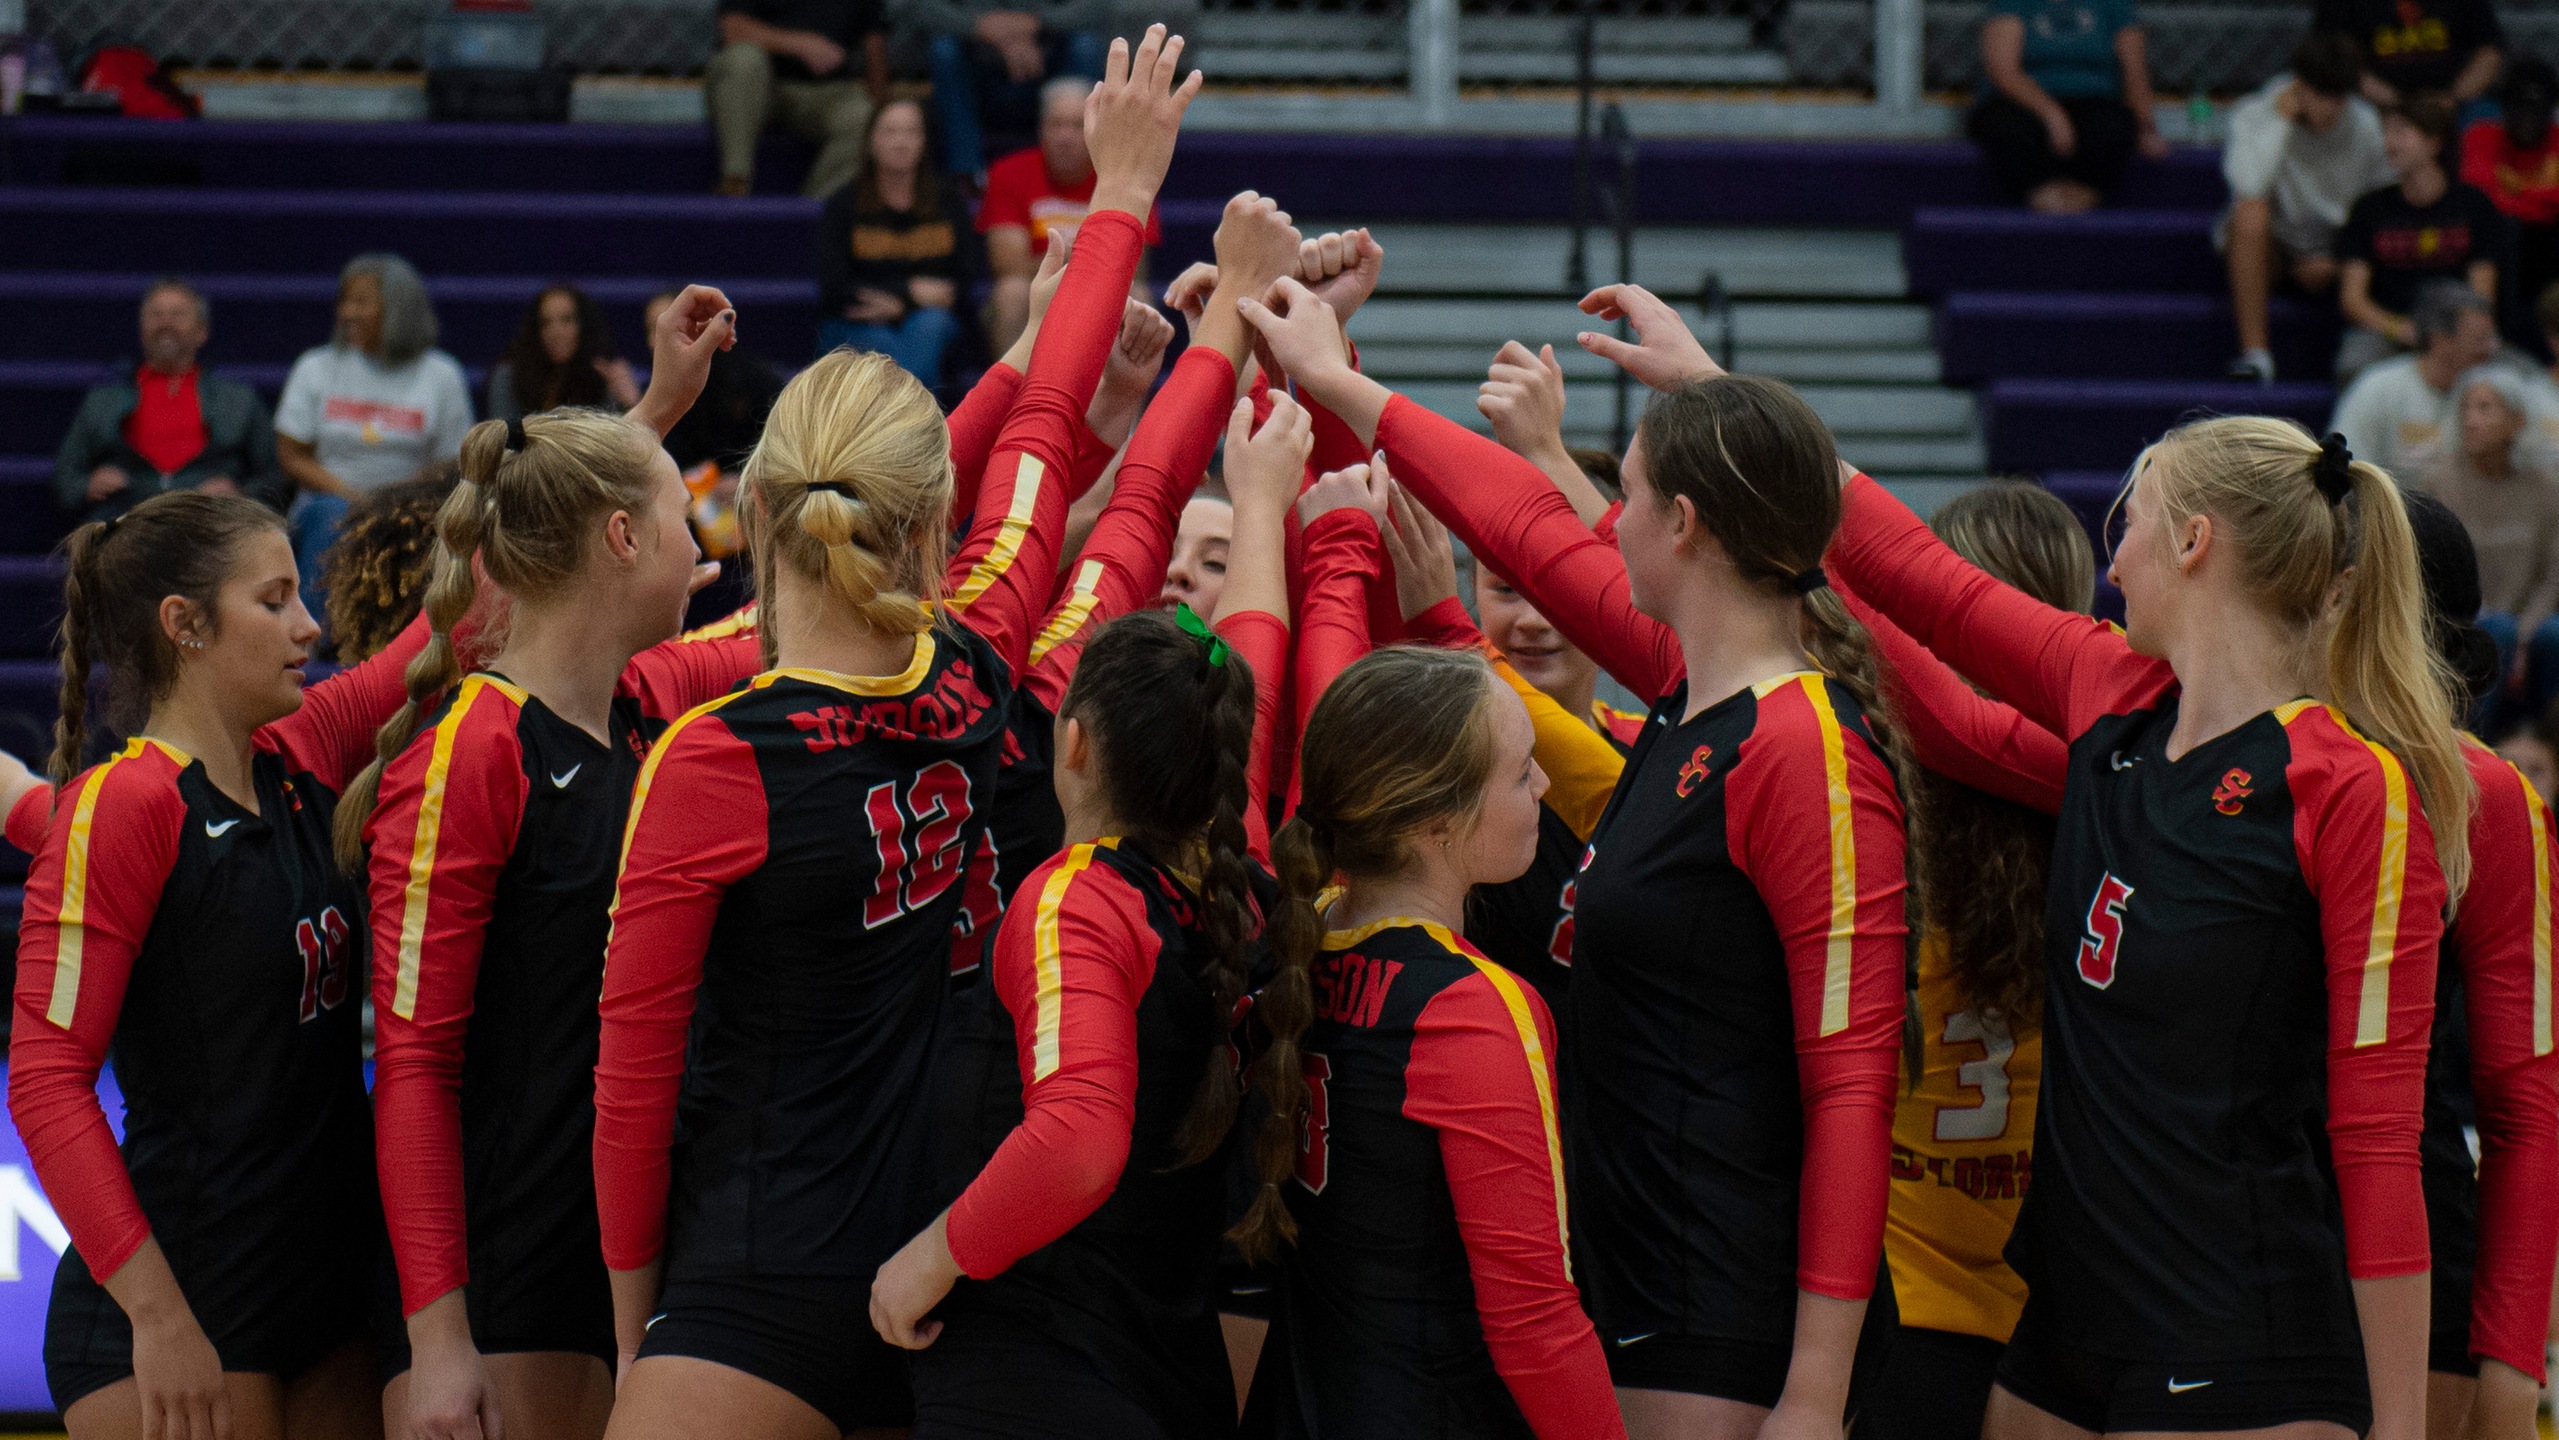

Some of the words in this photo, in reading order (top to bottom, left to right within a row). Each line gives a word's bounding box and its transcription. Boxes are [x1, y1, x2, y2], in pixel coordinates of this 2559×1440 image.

[864, 759, 974, 930] 12
[295, 905, 350, 1024] 19
[2076, 870, 2135, 990] 5
[1935, 1008, 2017, 1143] 3
